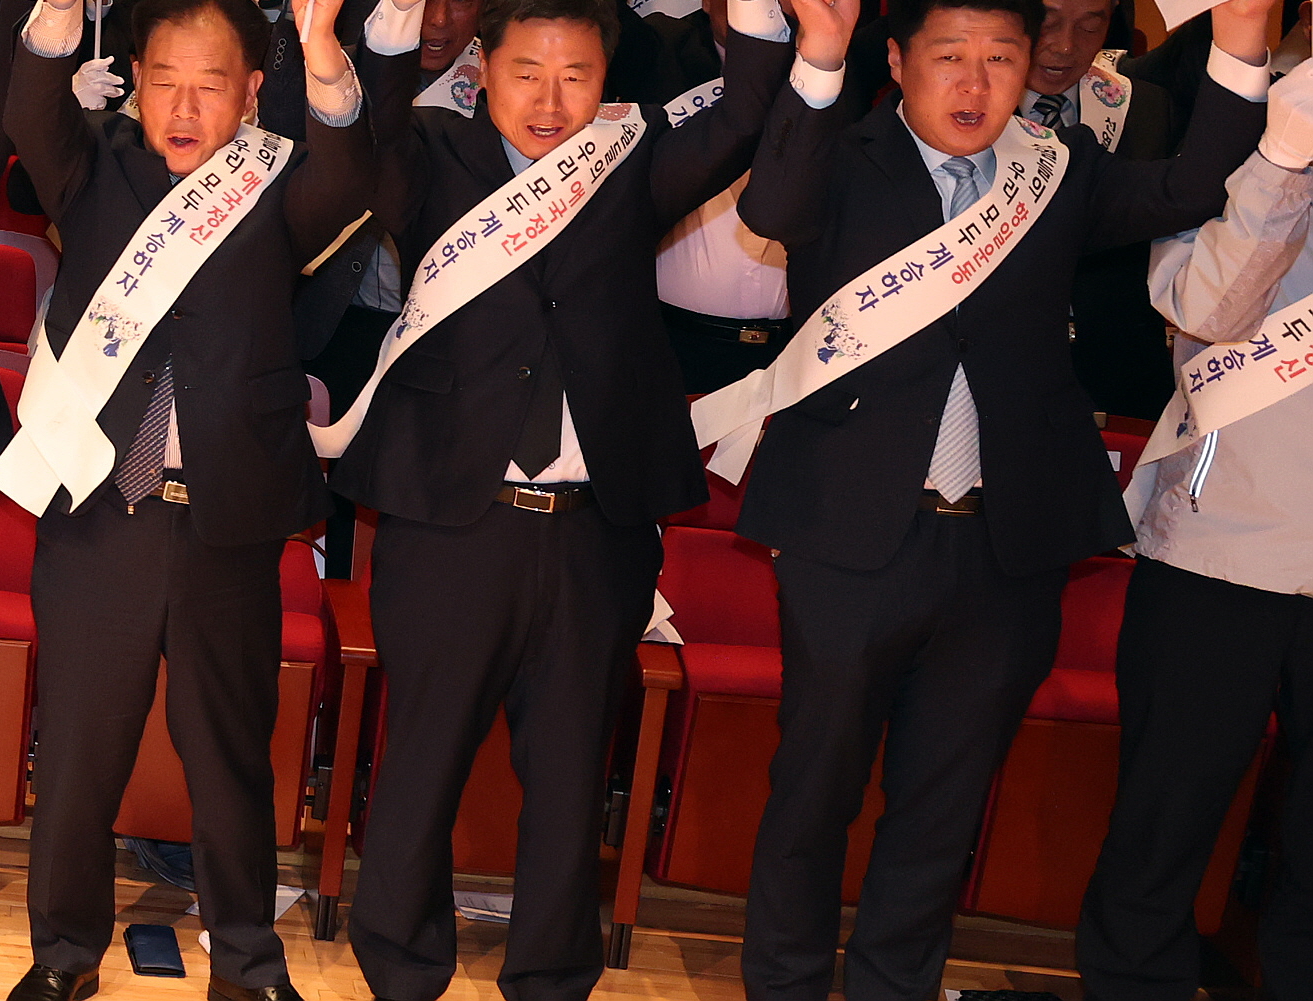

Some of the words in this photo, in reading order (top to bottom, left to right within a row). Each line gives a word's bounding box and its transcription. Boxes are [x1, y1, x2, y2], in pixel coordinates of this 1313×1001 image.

[223, 138, 252, 175] 우리
[556, 141, 597, 182] 우리
[1002, 161, 1026, 206] 우리
[180, 172, 222, 212] 모두
[188, 169, 263, 246] 애국정신
[501, 179, 587, 257] 애국정신
[506, 176, 552, 216] 모두
[115, 211, 187, 299] 계승하자
[422, 210, 504, 284] 계승하자
[951, 201, 1030, 286] 항일운동
[957, 203, 1002, 247] 모두
[855, 242, 955, 314] 계승하자
[1186, 333, 1277, 394] 계승하자
